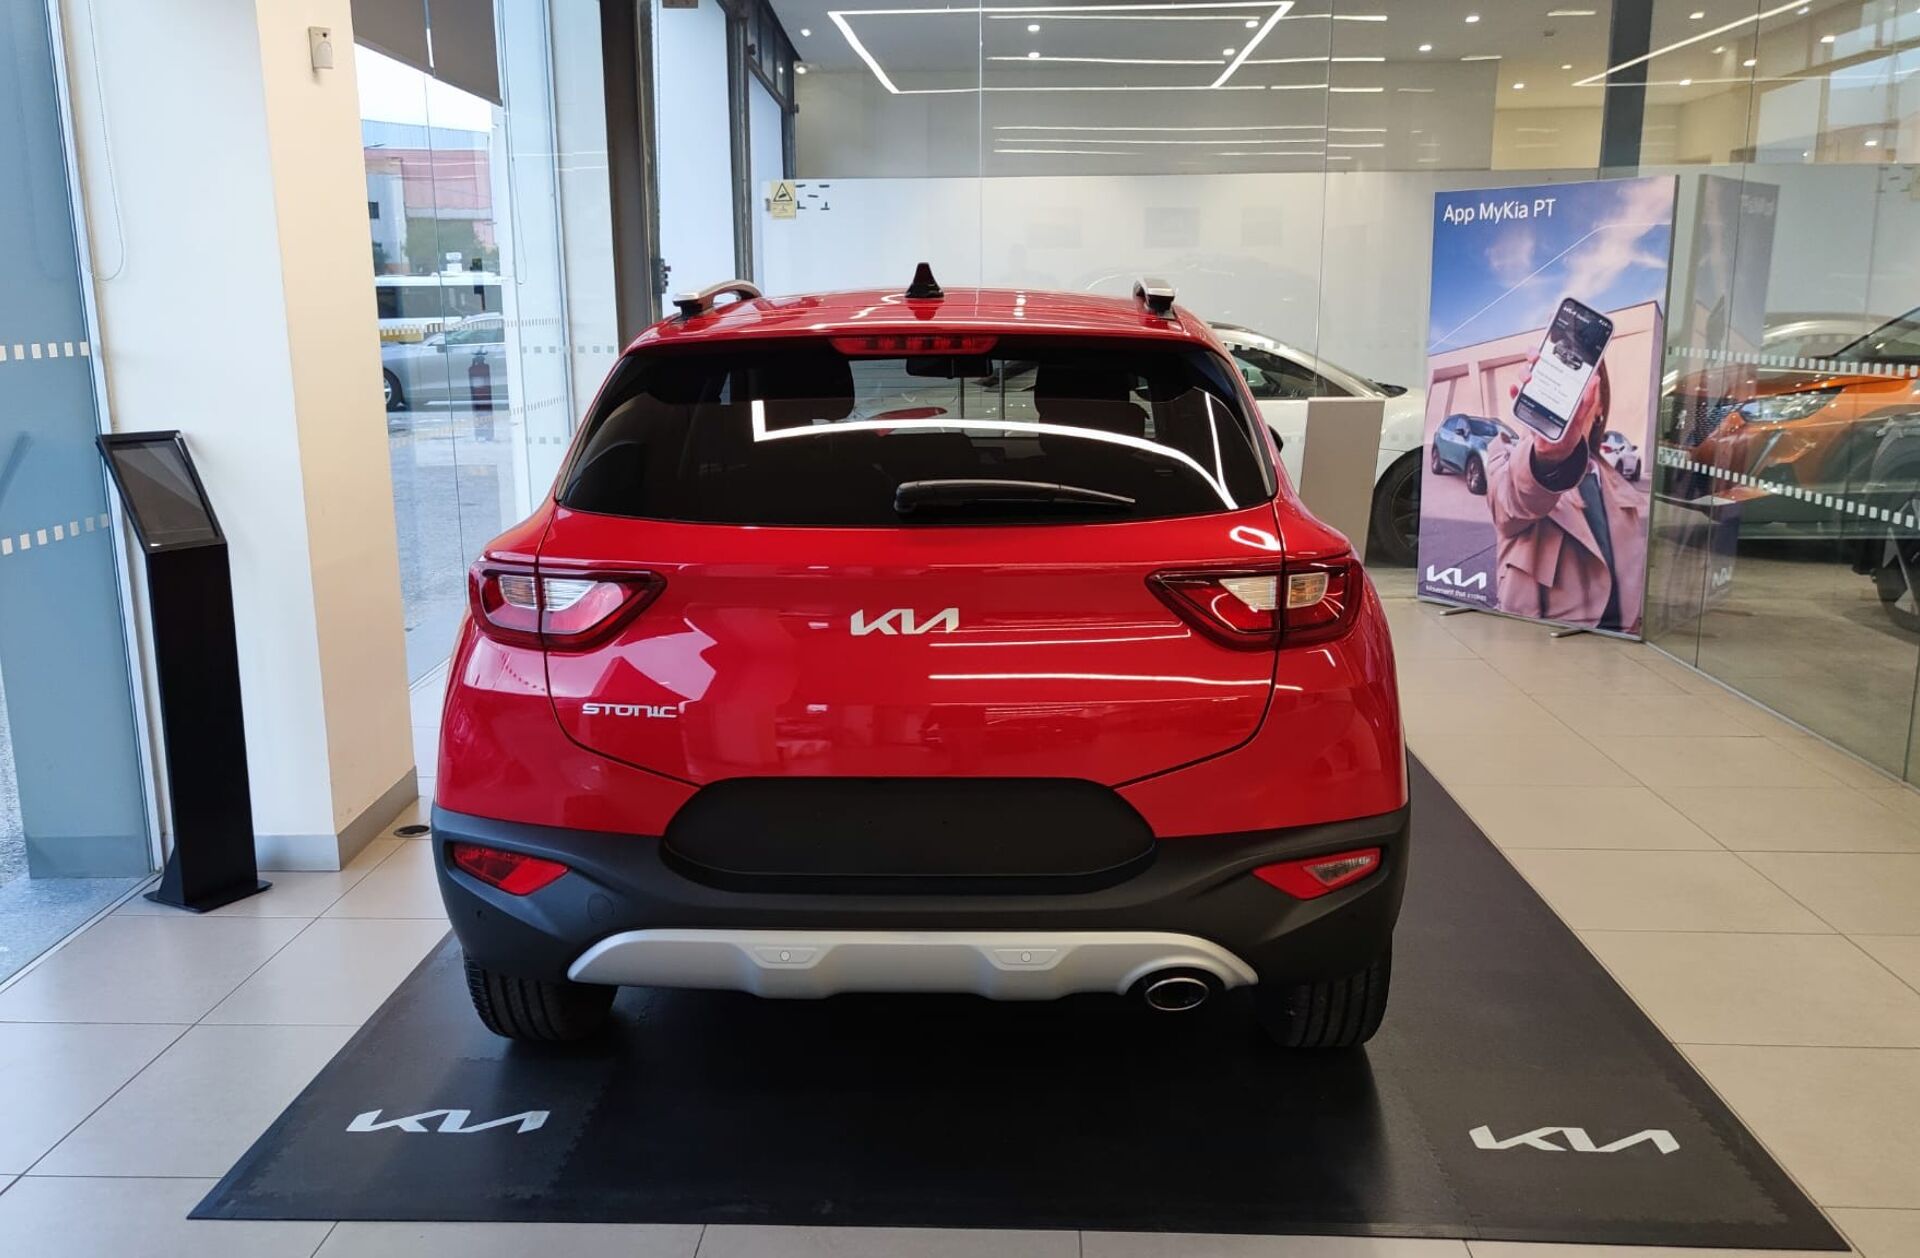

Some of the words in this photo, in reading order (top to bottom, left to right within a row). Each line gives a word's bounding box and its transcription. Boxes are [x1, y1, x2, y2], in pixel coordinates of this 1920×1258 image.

[1443, 204, 1475, 225] App
[1479, 201, 1529, 224] MyKia
[1533, 198, 1556, 217] PT
[1426, 564, 1487, 591] KIA
[850, 607, 960, 636] KIA
[582, 702, 678, 718] STONIC
[346, 1109, 550, 1134] KIA
[1468, 1125, 1680, 1154] KIA
